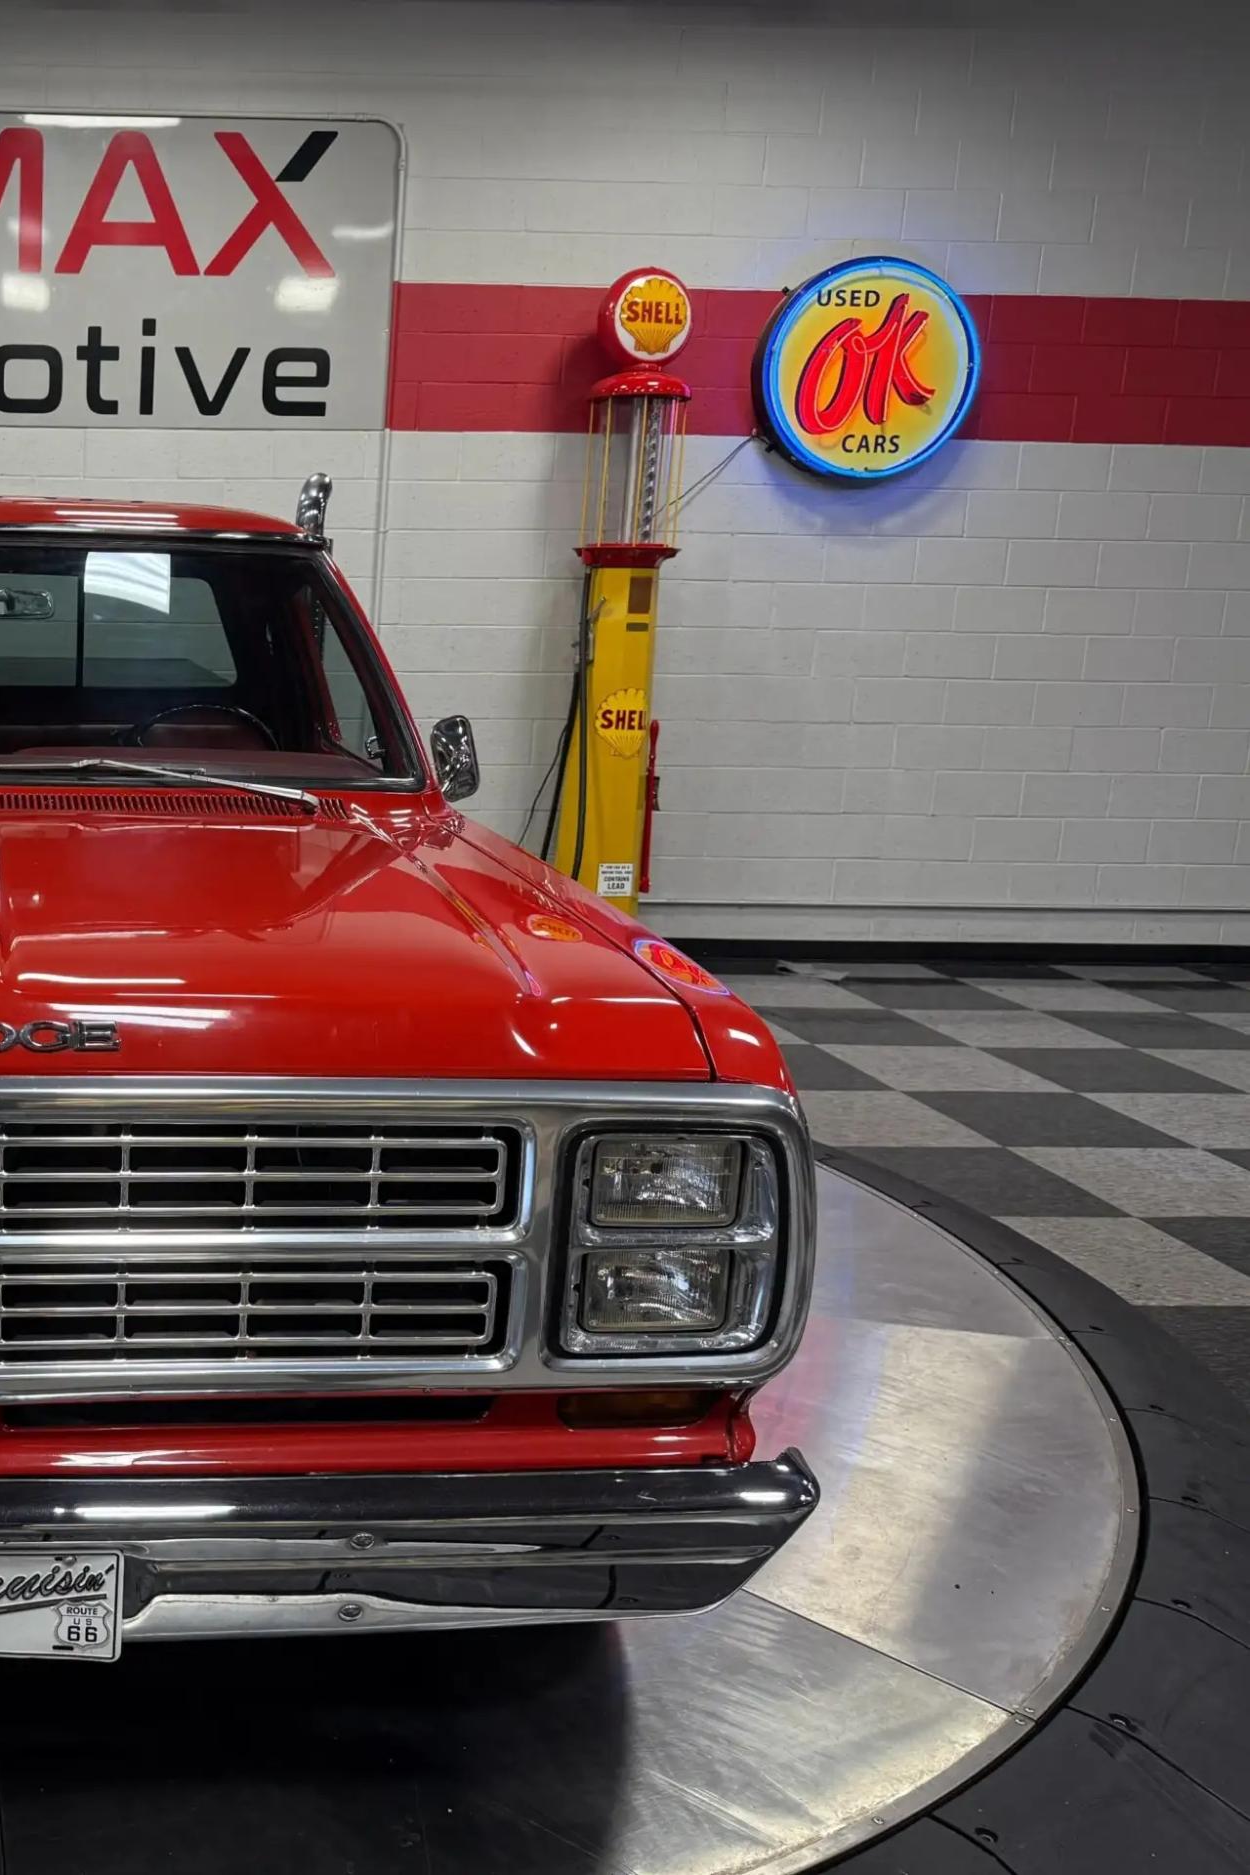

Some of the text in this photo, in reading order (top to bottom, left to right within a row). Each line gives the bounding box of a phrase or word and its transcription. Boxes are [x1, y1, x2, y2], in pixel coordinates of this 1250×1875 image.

[816, 289, 881, 308] USED
[626, 301, 683, 325] SHELL
[794, 293, 936, 435] OK
[841, 434, 900, 454] CARS
[66, 1606, 98, 1616] ROUTE
[67, 1625, 98, 1642] 66
